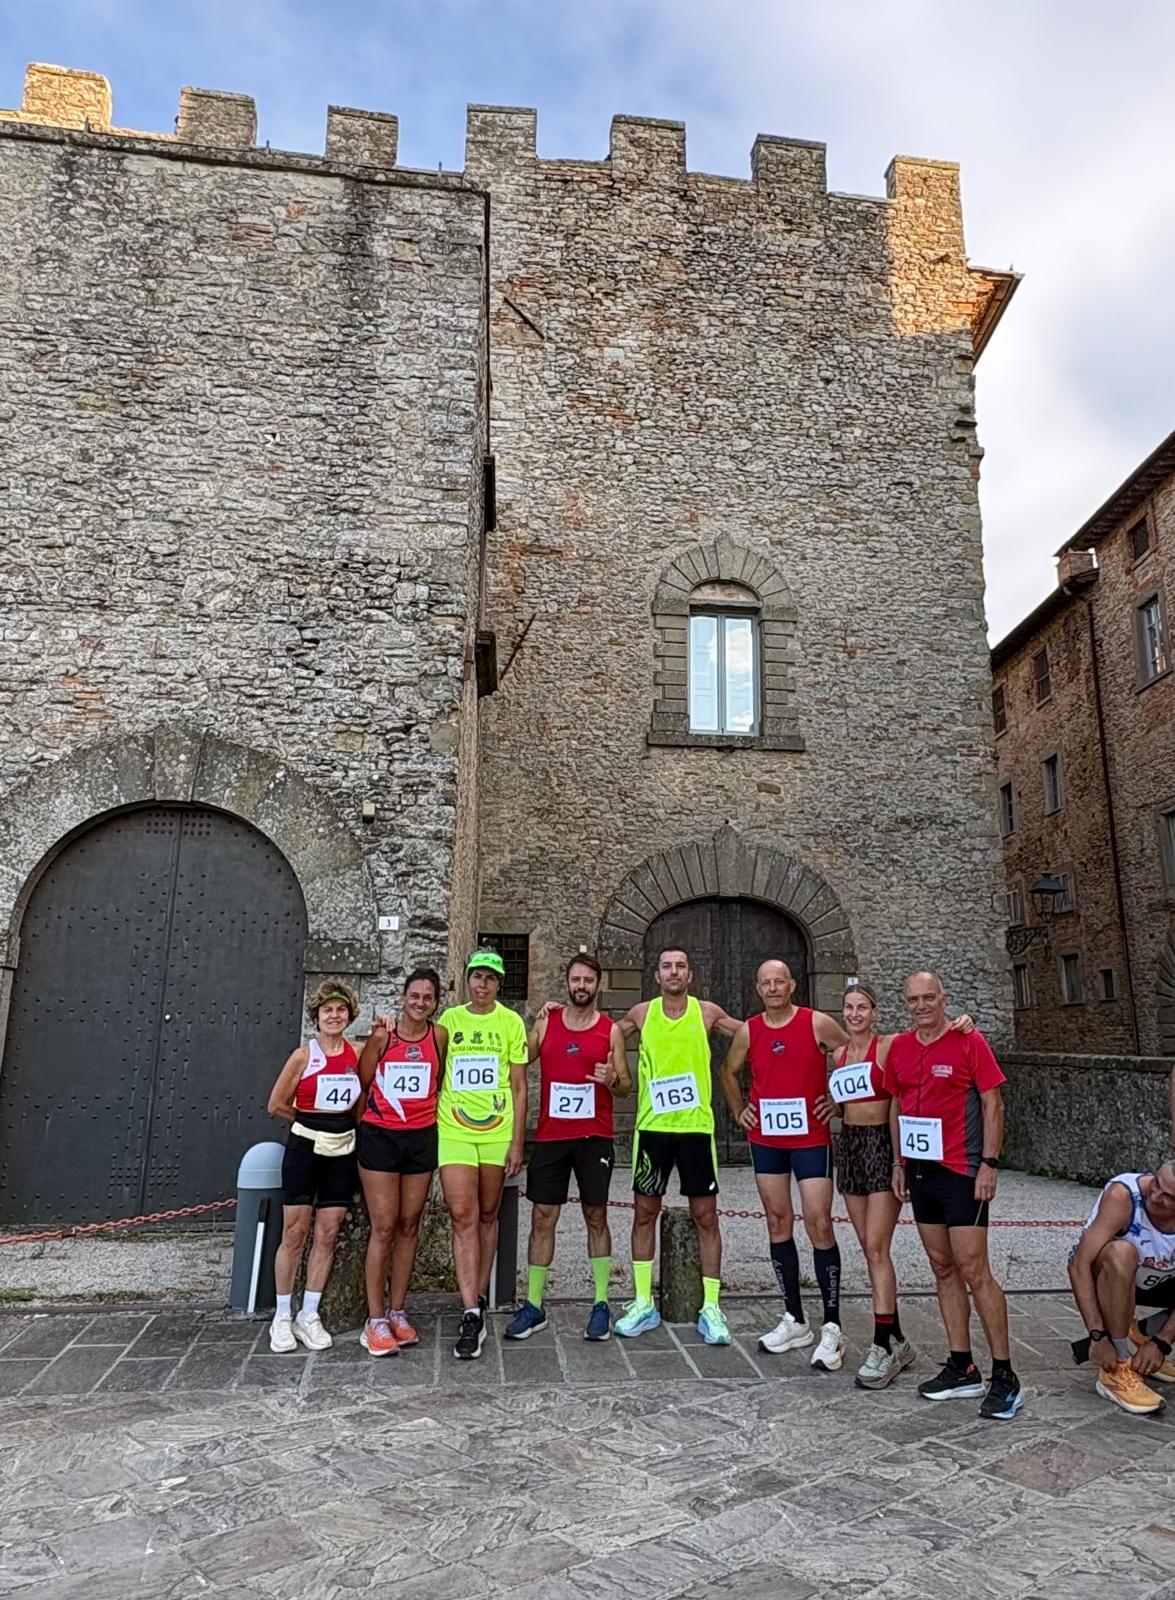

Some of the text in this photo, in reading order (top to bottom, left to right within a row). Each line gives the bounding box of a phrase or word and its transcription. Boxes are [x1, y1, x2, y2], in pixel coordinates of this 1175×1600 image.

[393, 1076, 420, 1093] 43
[456, 1068, 494, 1085] 106
[833, 1075, 868, 1097] 104
[325, 1088, 351, 1105] 44
[559, 1096, 584, 1113] 27
[655, 1086, 694, 1107] 163
[764, 1111, 803, 1130] 105
[905, 1132, 930, 1153] 45
